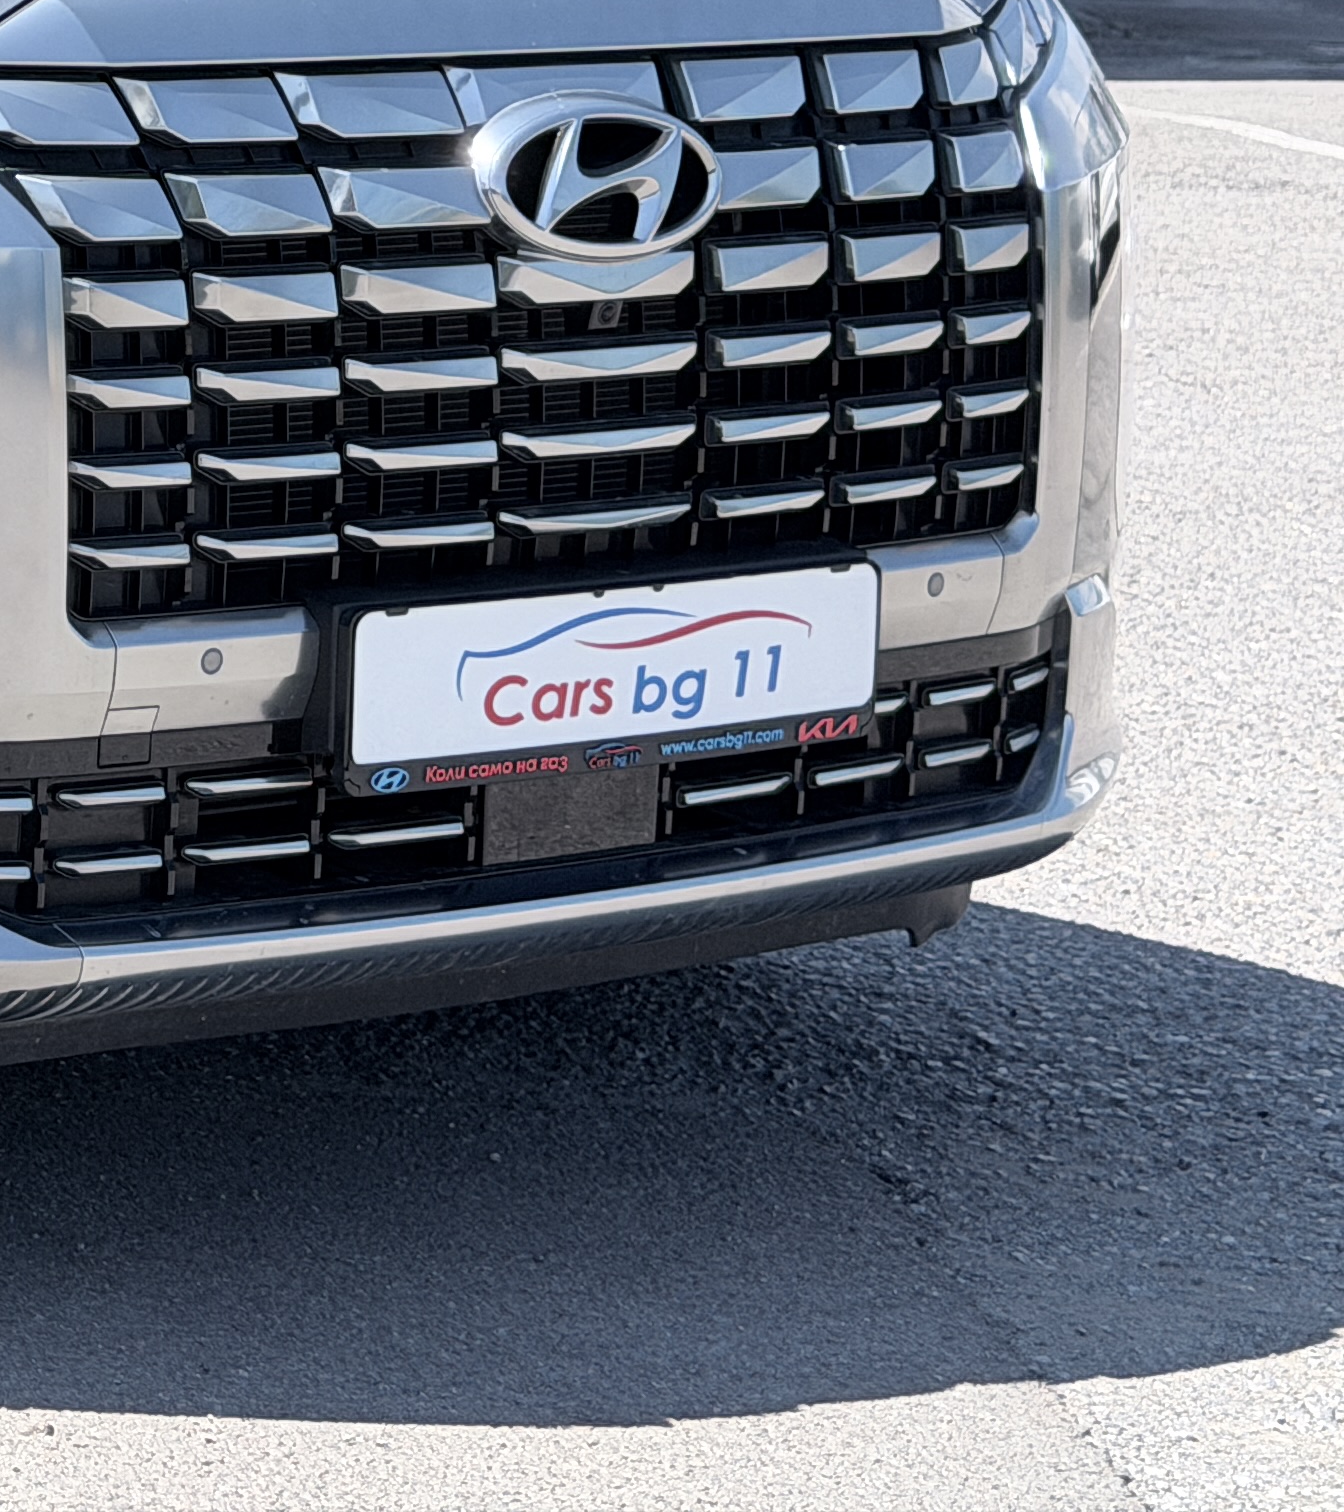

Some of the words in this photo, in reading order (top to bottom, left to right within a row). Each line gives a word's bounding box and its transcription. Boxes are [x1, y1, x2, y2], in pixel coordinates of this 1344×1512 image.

[483, 674, 614, 727] Cars
[631, 664, 707, 720] bg
[735, 644, 782, 698] 11
[661, 728, 785, 756] www.carsbg11.com
[797, 713, 859, 743] KIA
[425, 765, 466, 783] Коли
[468, 760, 514, 779] само
[515, 758, 538, 774] на
